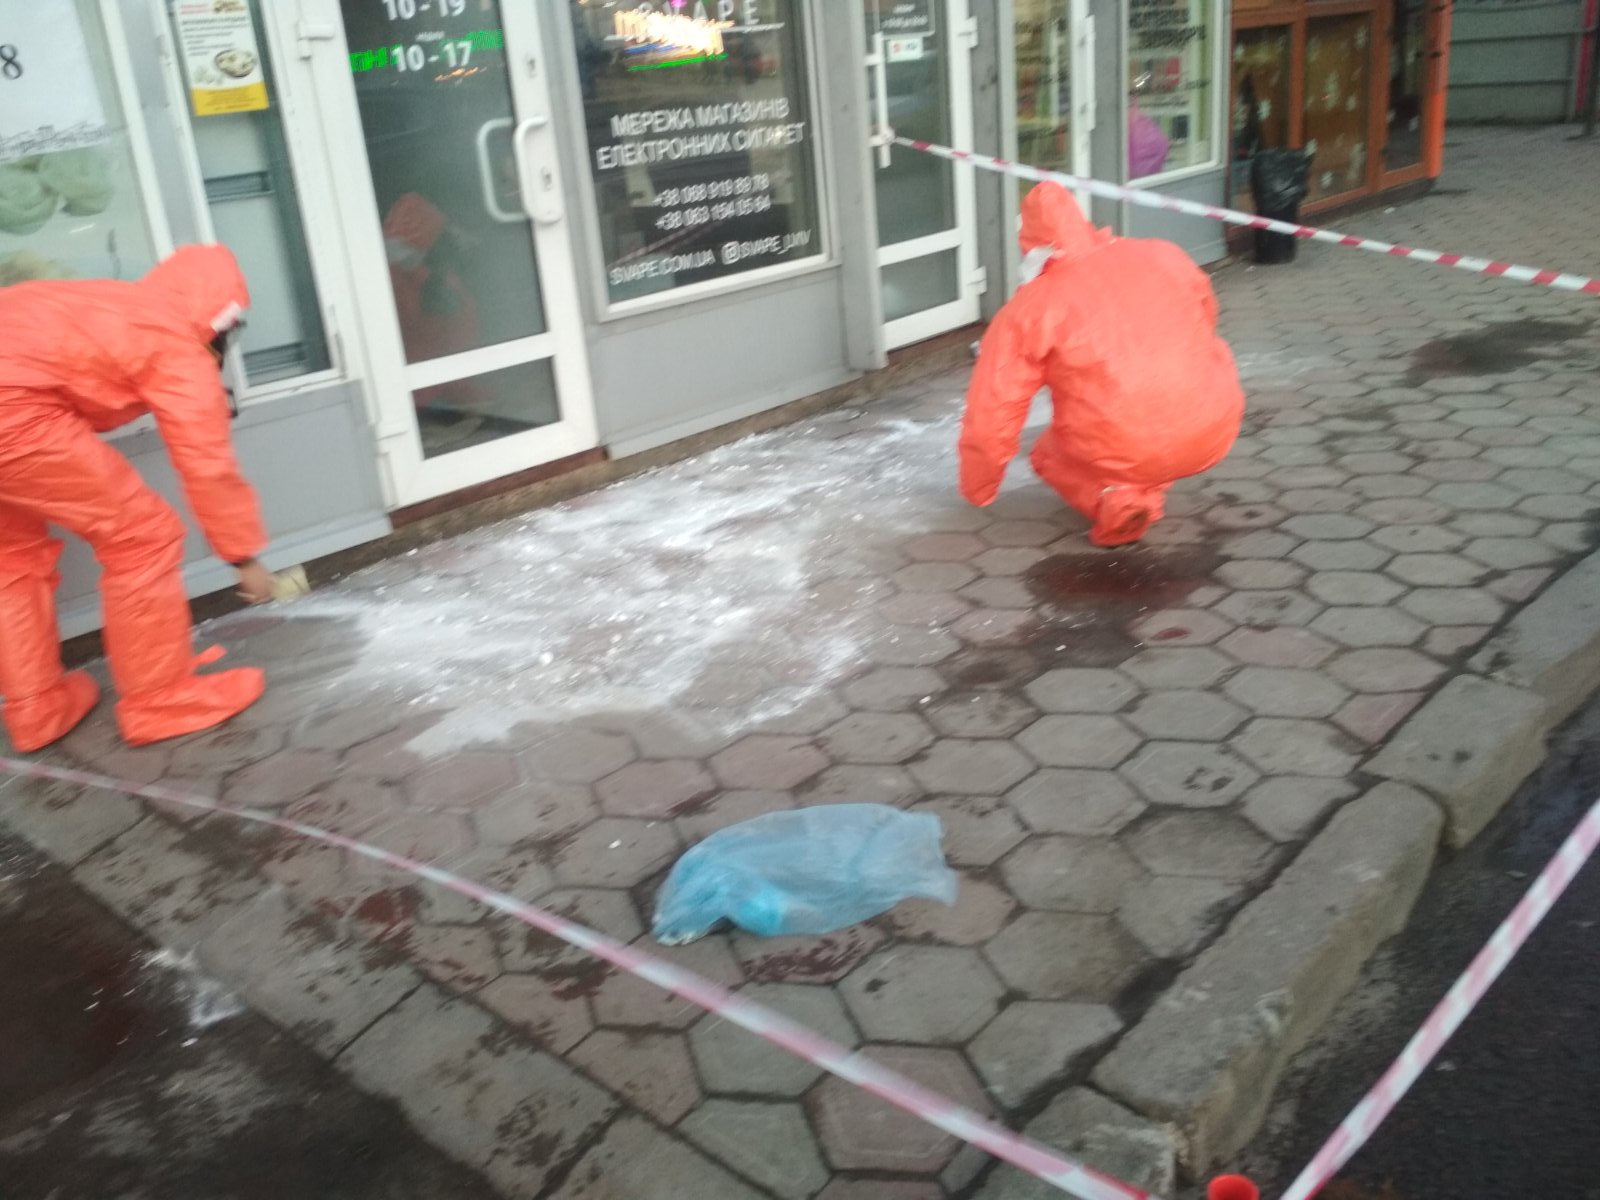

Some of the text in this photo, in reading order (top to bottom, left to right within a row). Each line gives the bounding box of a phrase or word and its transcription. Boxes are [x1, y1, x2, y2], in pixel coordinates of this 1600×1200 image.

[382, 0, 417, 21] 10
[640, 0, 760, 25] VAPE
[390, 43, 425, 73] 10
[443, 40, 474, 68] 17
[610, 97, 789, 138] МЕРЕЖА МАГАЗИНІВ
[596, 123, 805, 170] ЕЛЕКТРОННИХ СИГАРЕТ
[652, 187, 680, 208] +38
[655, 210, 683, 231] +38
[610, 249, 716, 286] SVAPE.COM.UA
